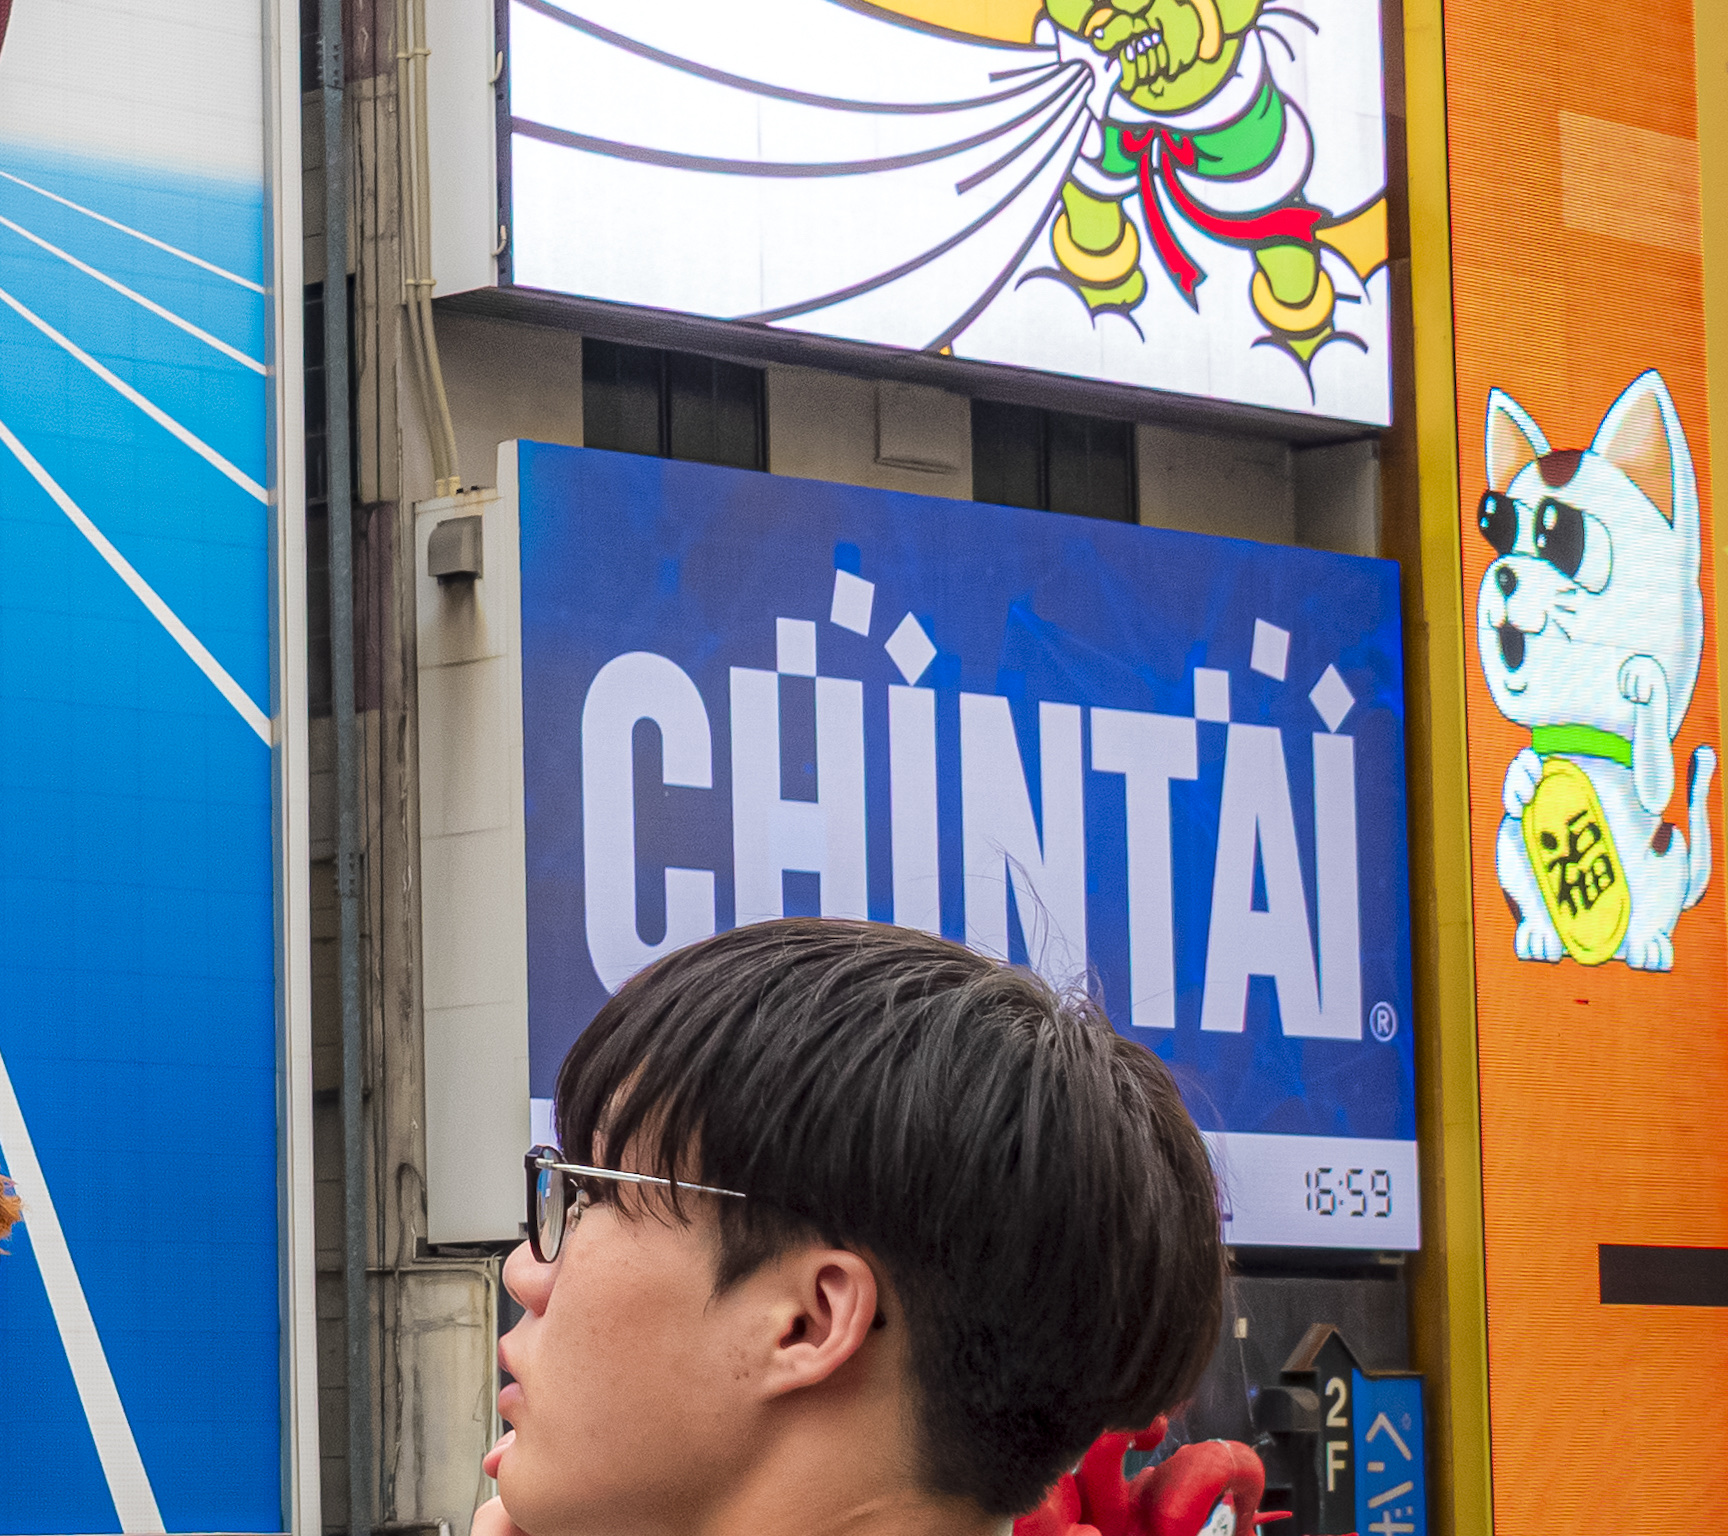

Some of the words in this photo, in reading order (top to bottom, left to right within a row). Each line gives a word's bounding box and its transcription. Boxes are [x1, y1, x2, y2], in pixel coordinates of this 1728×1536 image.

[581, 568, 1364, 1041] CHINTAI
[1305, 1166, 1393, 1218] 16:59
[1324, 1376, 1349, 1493] 2F
